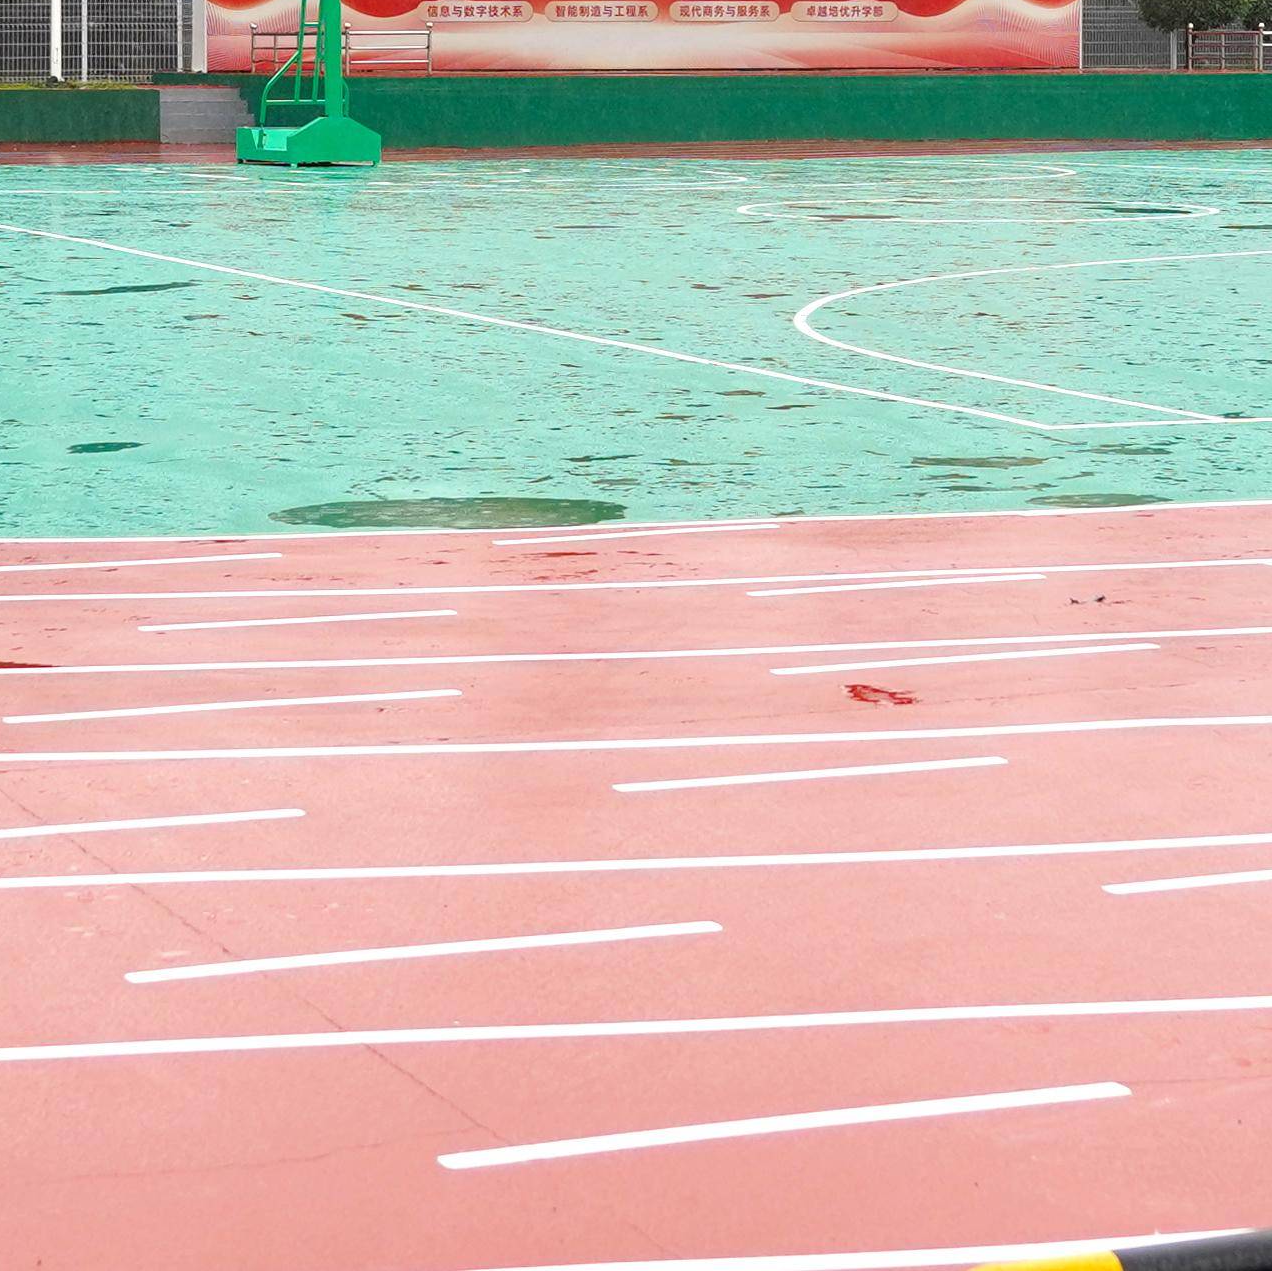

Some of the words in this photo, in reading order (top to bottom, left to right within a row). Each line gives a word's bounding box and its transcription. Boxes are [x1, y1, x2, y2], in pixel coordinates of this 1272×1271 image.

[427, 5, 524, 18] 信息与数字技术系
[555, 5, 649, 18] 智能制造与工程系
[679, 5, 771, 18] 现代商务与服务系
[806, 5, 884, 18] 卓越培优升学部
